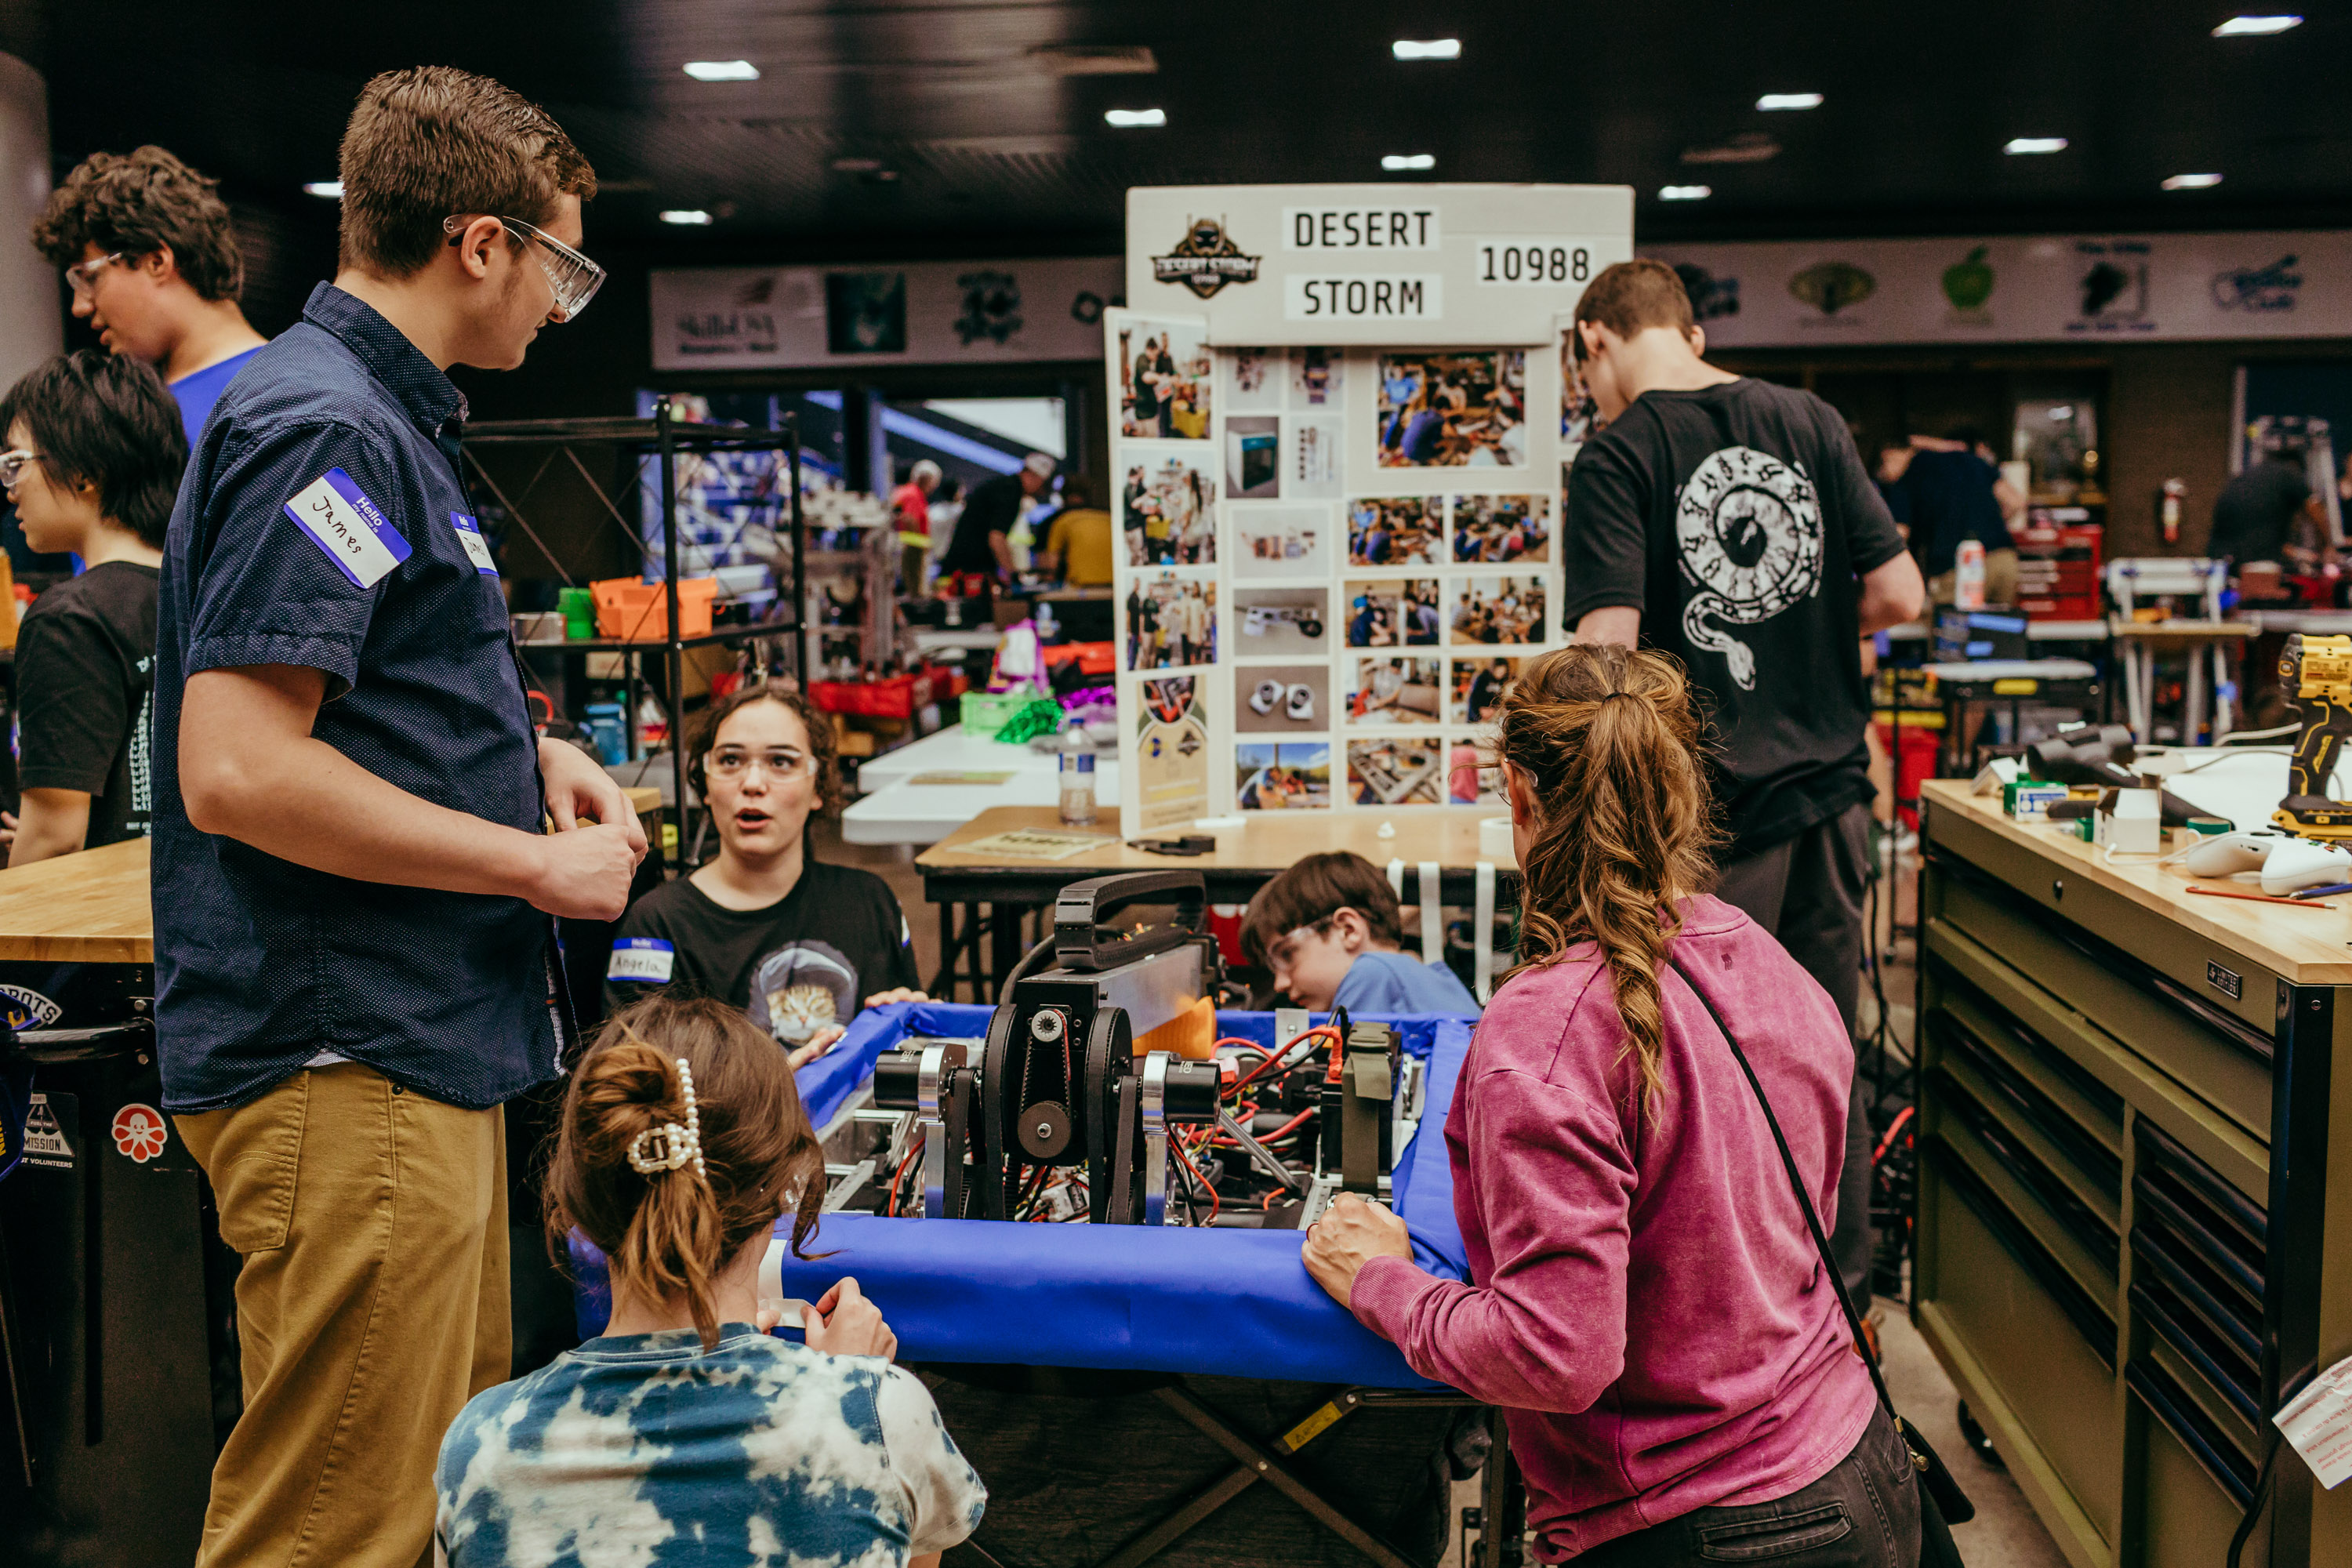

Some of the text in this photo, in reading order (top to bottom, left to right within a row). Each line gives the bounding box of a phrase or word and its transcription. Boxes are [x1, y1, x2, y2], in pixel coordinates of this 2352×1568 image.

[1294, 211, 1432, 247] DESERT
[1481, 246, 1590, 282] 10988
[1304, 280, 1423, 315] STORM
[351, 503, 361, 514] my
[360, 512, 374, 528] name
[356, 497, 383, 526] Hello
[313, 495, 361, 554] James
[614, 956, 662, 974] Angela
[2217, 968, 2237, 985] LIMITED
[2217, 976, 2236, 993] EDITION
[24, 1136, 61, 1152] MISSION
[30, 1158, 73, 1168] VOLUNTEERS
